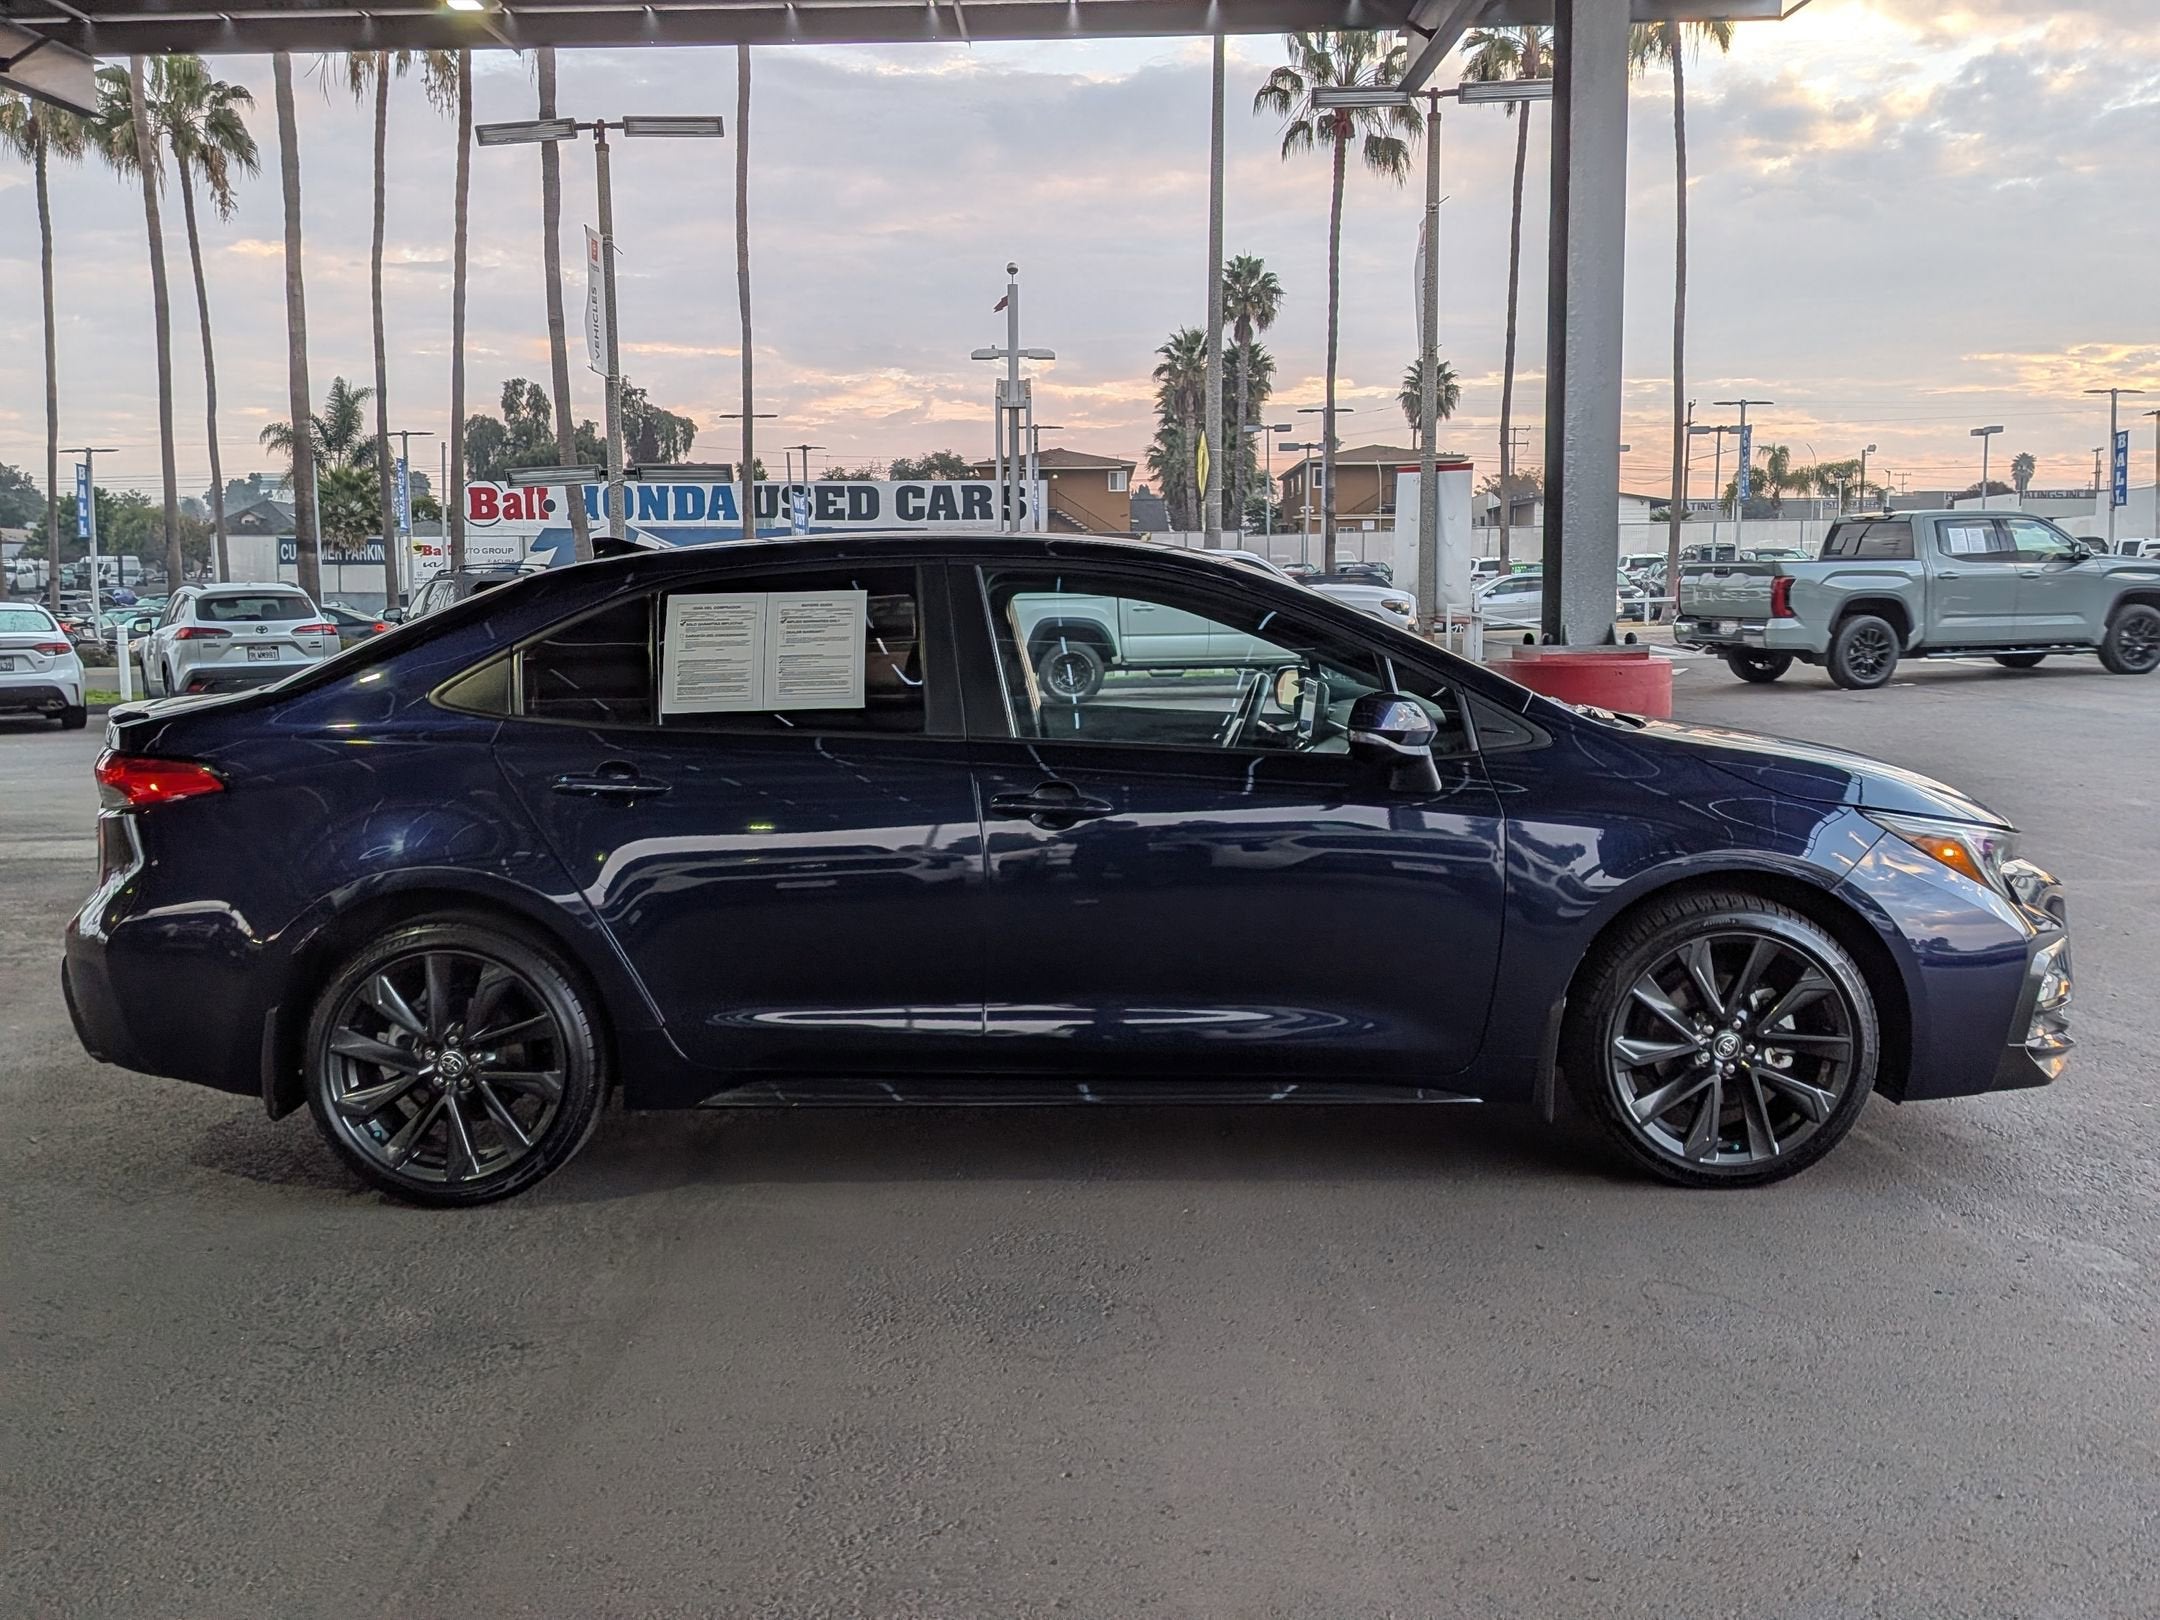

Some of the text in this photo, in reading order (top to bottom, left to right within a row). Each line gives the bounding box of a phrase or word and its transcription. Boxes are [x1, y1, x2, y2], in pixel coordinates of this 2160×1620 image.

[590, 287, 601, 359] VEHICLES
[2115, 434, 2127, 503] BALL
[77, 466, 88, 535] BALL
[468, 487, 550, 520] Ball
[345, 544, 385, 561] PARKIN
[481, 547, 514, 555] GROUP
